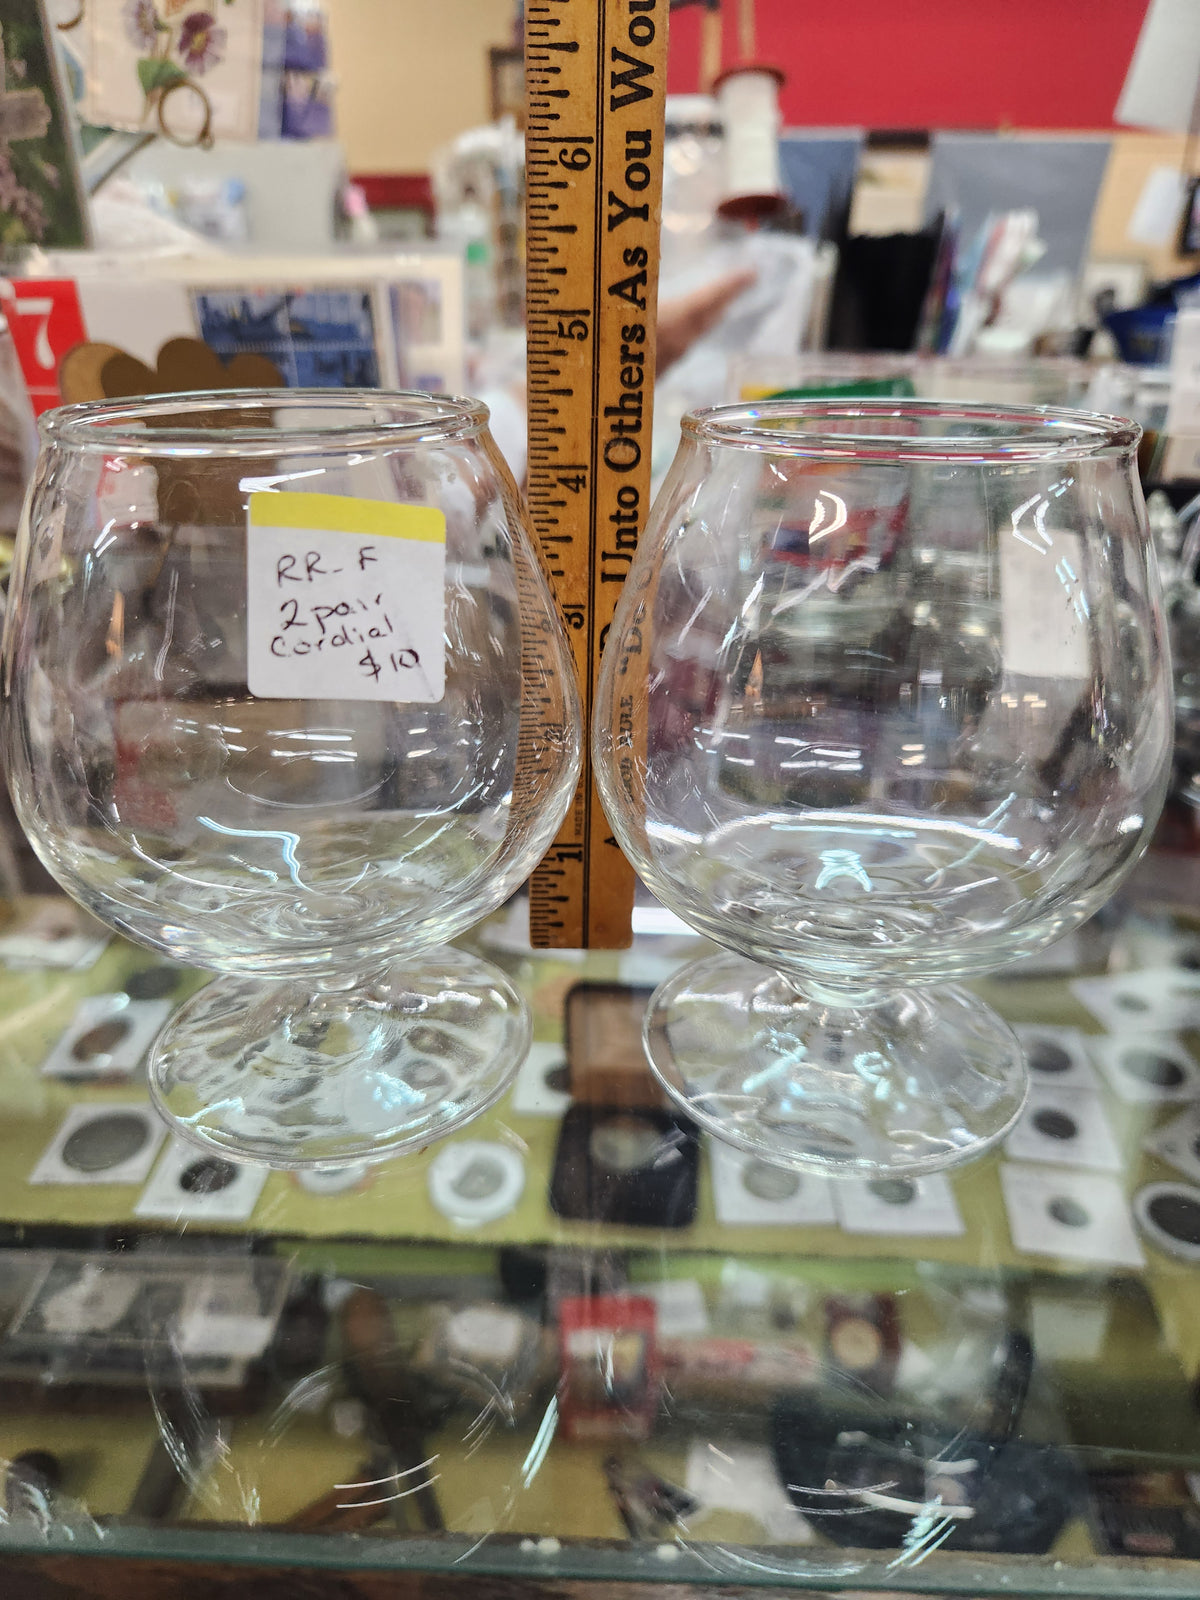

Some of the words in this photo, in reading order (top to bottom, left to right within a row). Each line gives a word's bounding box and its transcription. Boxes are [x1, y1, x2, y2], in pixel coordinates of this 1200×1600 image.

[559, 147, 591, 171] 6
[608, 129, 652, 232] You
[608, 246, 648, 310] As
[16, 297, 55, 370] 7
[557, 319, 588, 341] 5
[603, 324, 645, 473] Others
[556, 475, 586, 494] 4
[601, 486, 639, 583] Unto
[359, 546, 378, 571] F
[280, 599, 307, 631] 2
[310, 593, 383, 634] pair
[359, 648, 420, 683] $10
[556, 850, 583, 863] 1
